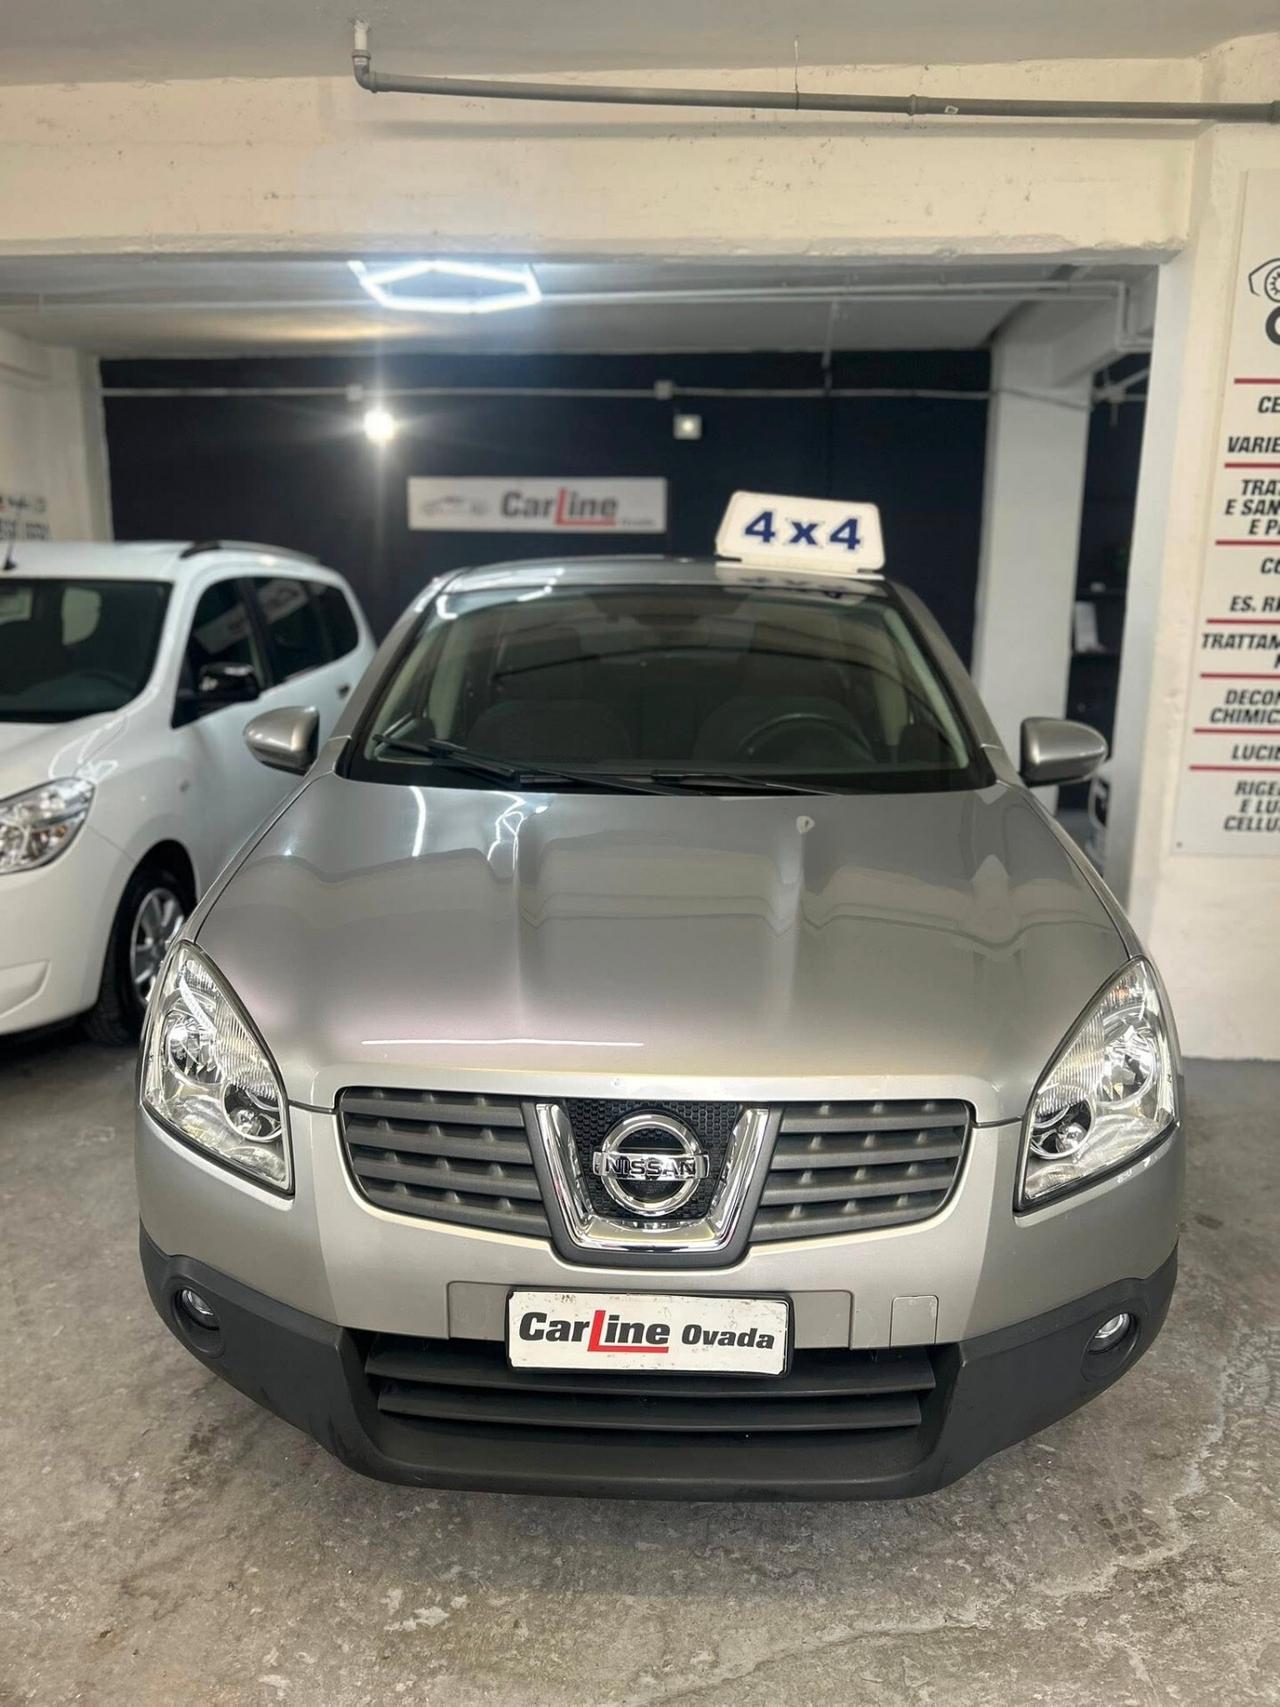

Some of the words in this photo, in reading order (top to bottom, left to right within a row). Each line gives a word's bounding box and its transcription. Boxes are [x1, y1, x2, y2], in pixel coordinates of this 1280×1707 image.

[501, 486, 619, 526] CarLine
[1225, 499, 1237, 515] E
[1248, 518, 1261, 536] E
[1265, 518, 1280, 536] P
[1230, 595, 1256, 612] ES.
[1234, 780, 1280, 796] RIGE
[1256, 799, 1280, 814] LU
[1224, 816, 1280, 832] CELLU
[605, 1158, 696, 1177] NISSAN
[518, 1310, 671, 1354] CarLine
[681, 1323, 775, 1350] Ovada
